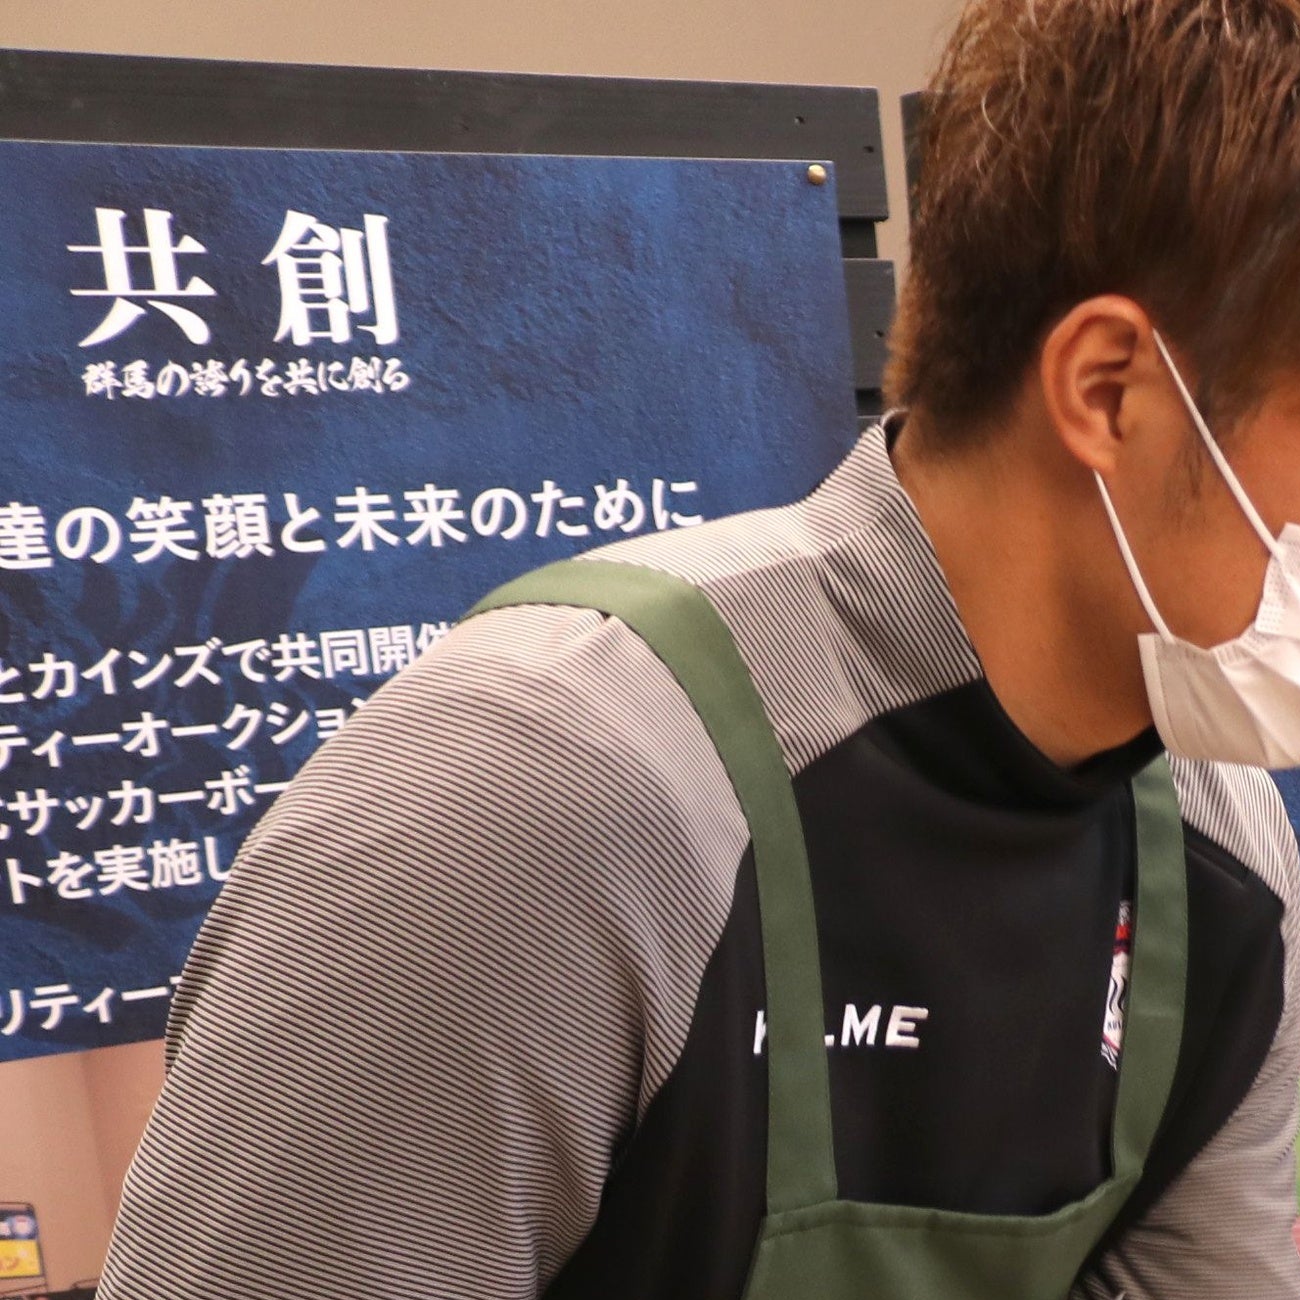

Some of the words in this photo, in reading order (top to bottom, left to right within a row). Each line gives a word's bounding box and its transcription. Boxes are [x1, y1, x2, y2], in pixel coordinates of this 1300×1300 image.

[67, 208, 402, 347] 共創
[82, 358, 410, 398] 群馬の誇りを共に創る
[0, 698, 366, 770] ティーオークショ
[0, 770, 291, 840] サッカーボー
[0, 975, 182, 1036] リティー
